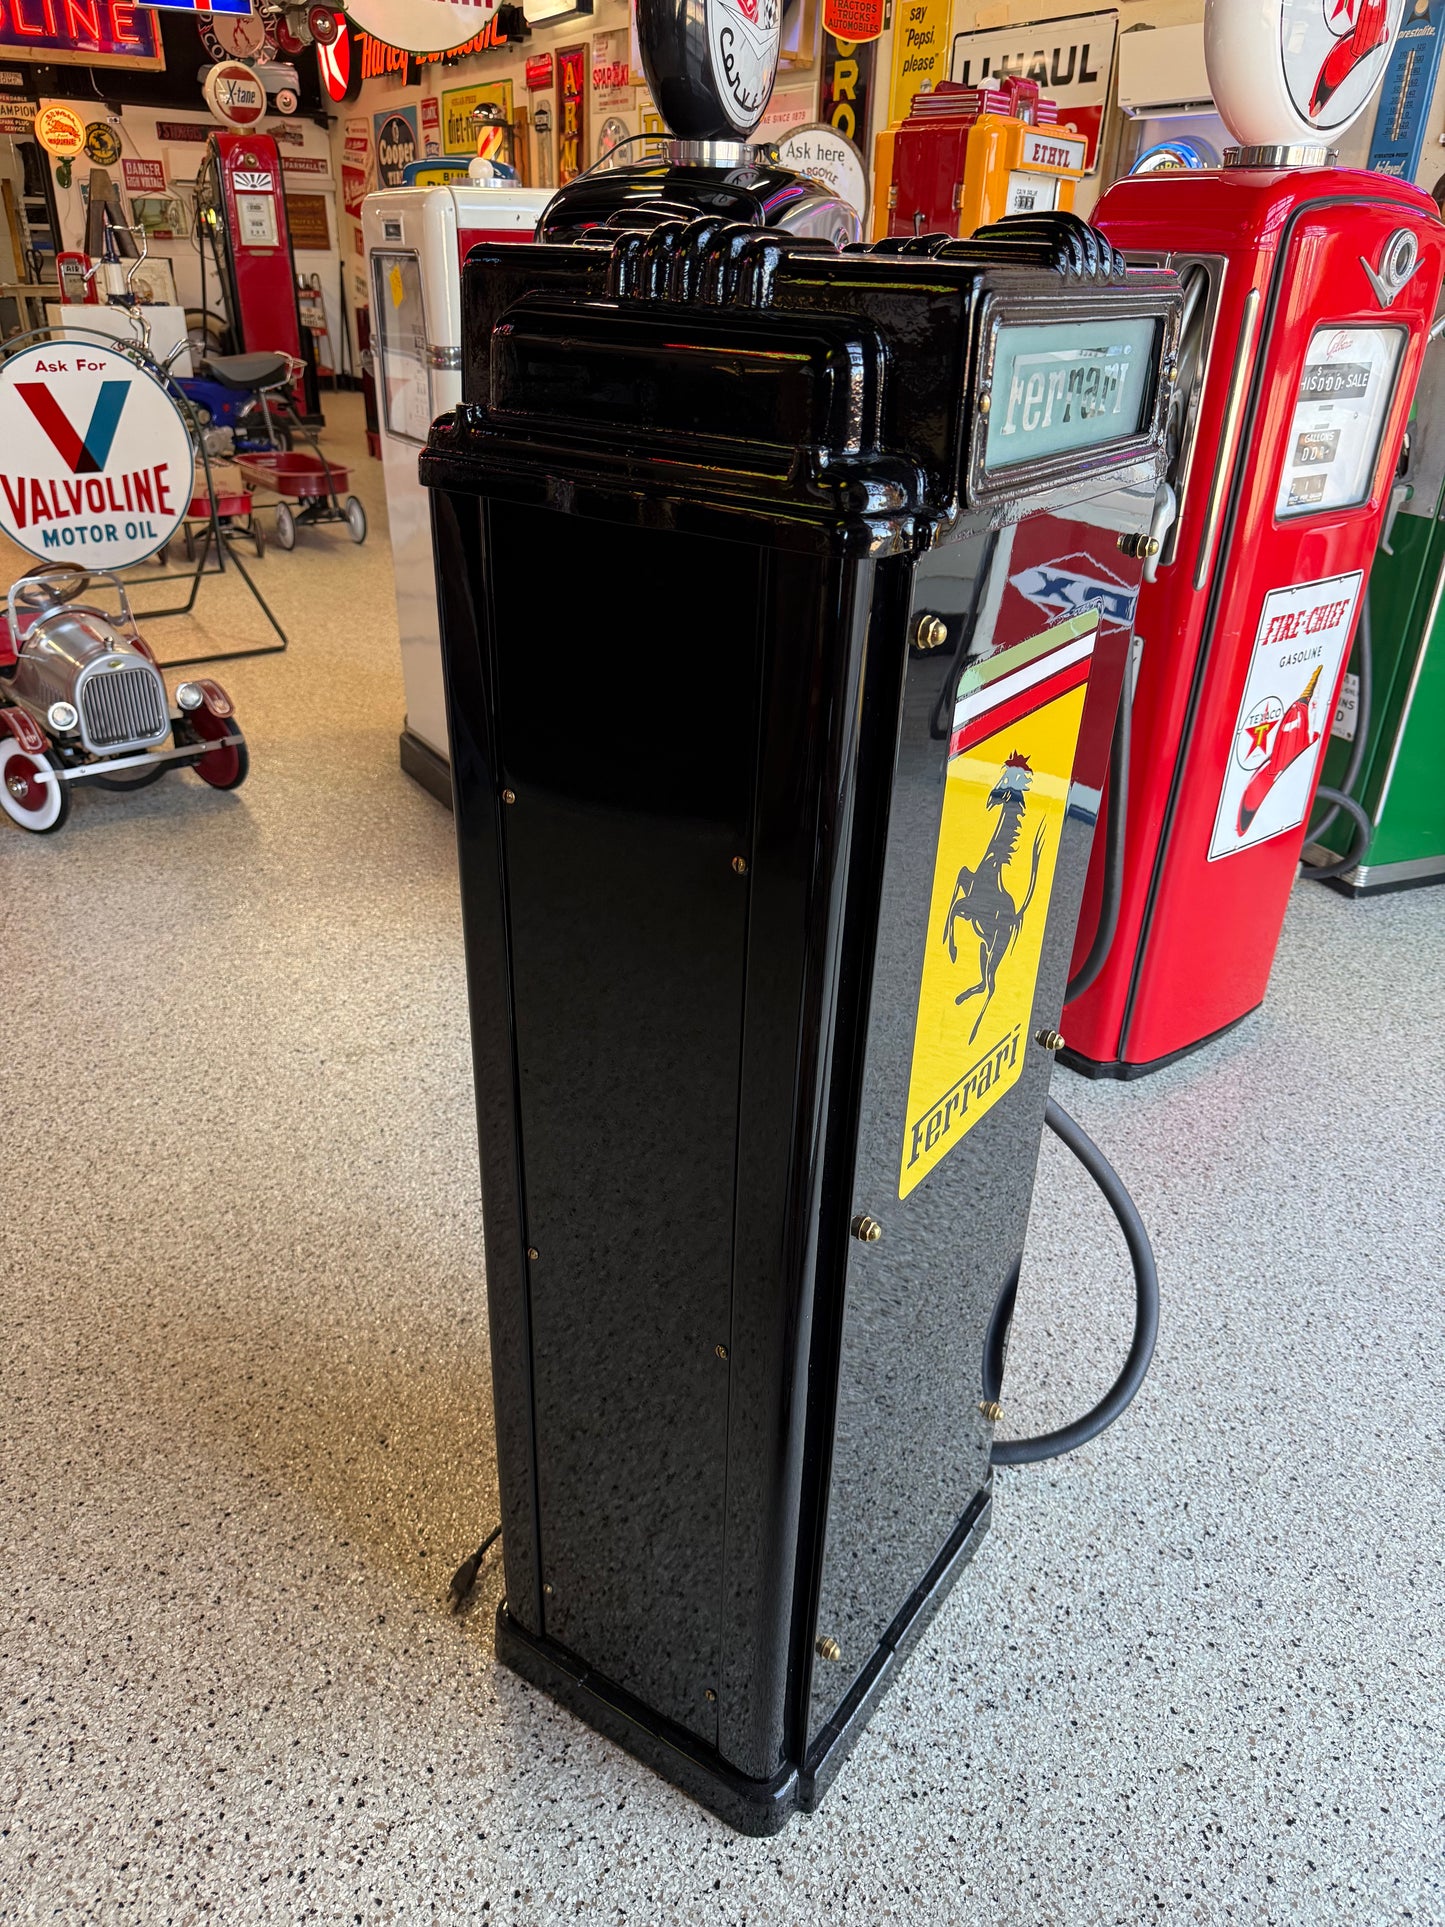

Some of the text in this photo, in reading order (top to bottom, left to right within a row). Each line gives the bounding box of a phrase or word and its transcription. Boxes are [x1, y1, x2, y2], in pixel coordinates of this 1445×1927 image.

[833, 0, 877, 13] TRACTORS
[838, 10, 871, 21] TRUCKS
[910, 5, 927, 21] say
[0, 0, 141, 43] LINE
[828, 19, 879, 33] AUTOMOBILES
[354, 31, 408, 86] Harley
[226, 80, 256, 105] X-tane
[772, 113, 790, 123] SINCE
[380, 139, 414, 169] Cooper
[786, 141, 845, 162] Ask here
[1032, 143, 1070, 168] ETHYL
[126, 161, 162, 176] DANGER
[800, 166, 838, 185] ARGOYLE
[66, 265, 80, 273] AIR
[35, 358, 107, 373] Ask For
[1346, 372, 1369, 388] SALE
[1304, 431, 1335, 444] GALLONS
[0, 462, 177, 530] VALVOLINE
[41, 521, 158, 549] MOTOR OIL
[1261, 599, 1351, 647] FIRE-CHIEF
[1279, 645, 1323, 668] GASOLINE
[1249, 707, 1282, 726] TEXACO
[907, 1023, 1022, 1170] Ferrari
